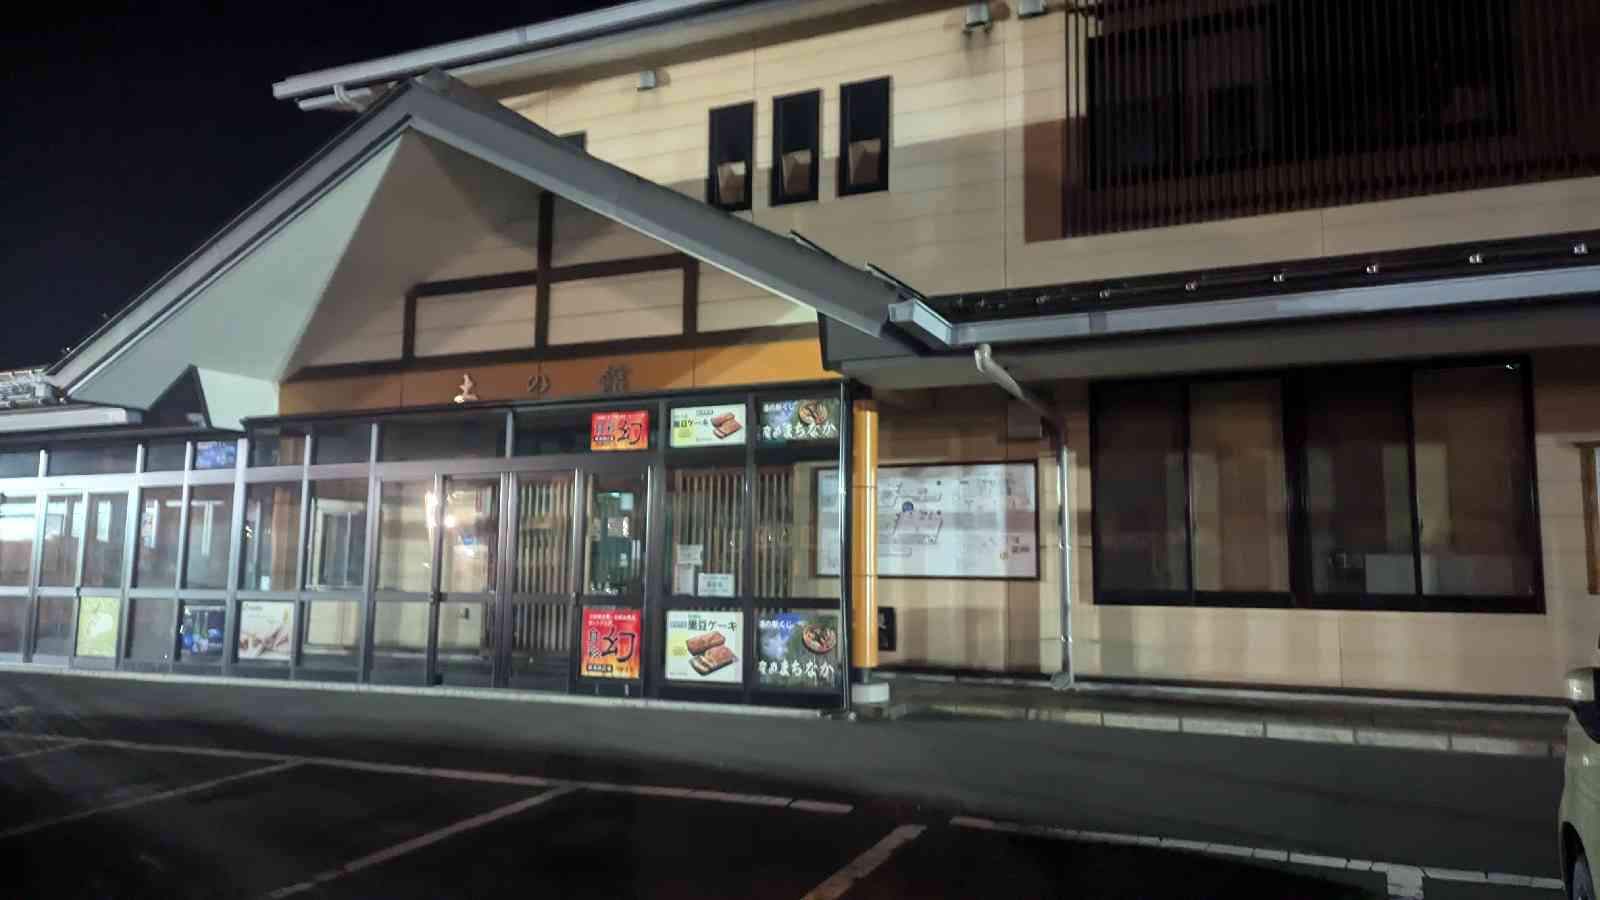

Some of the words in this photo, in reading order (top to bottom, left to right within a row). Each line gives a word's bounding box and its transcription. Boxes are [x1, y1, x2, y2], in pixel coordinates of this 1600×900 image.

[687, 619, 737, 632] 黒豆ケーキ
